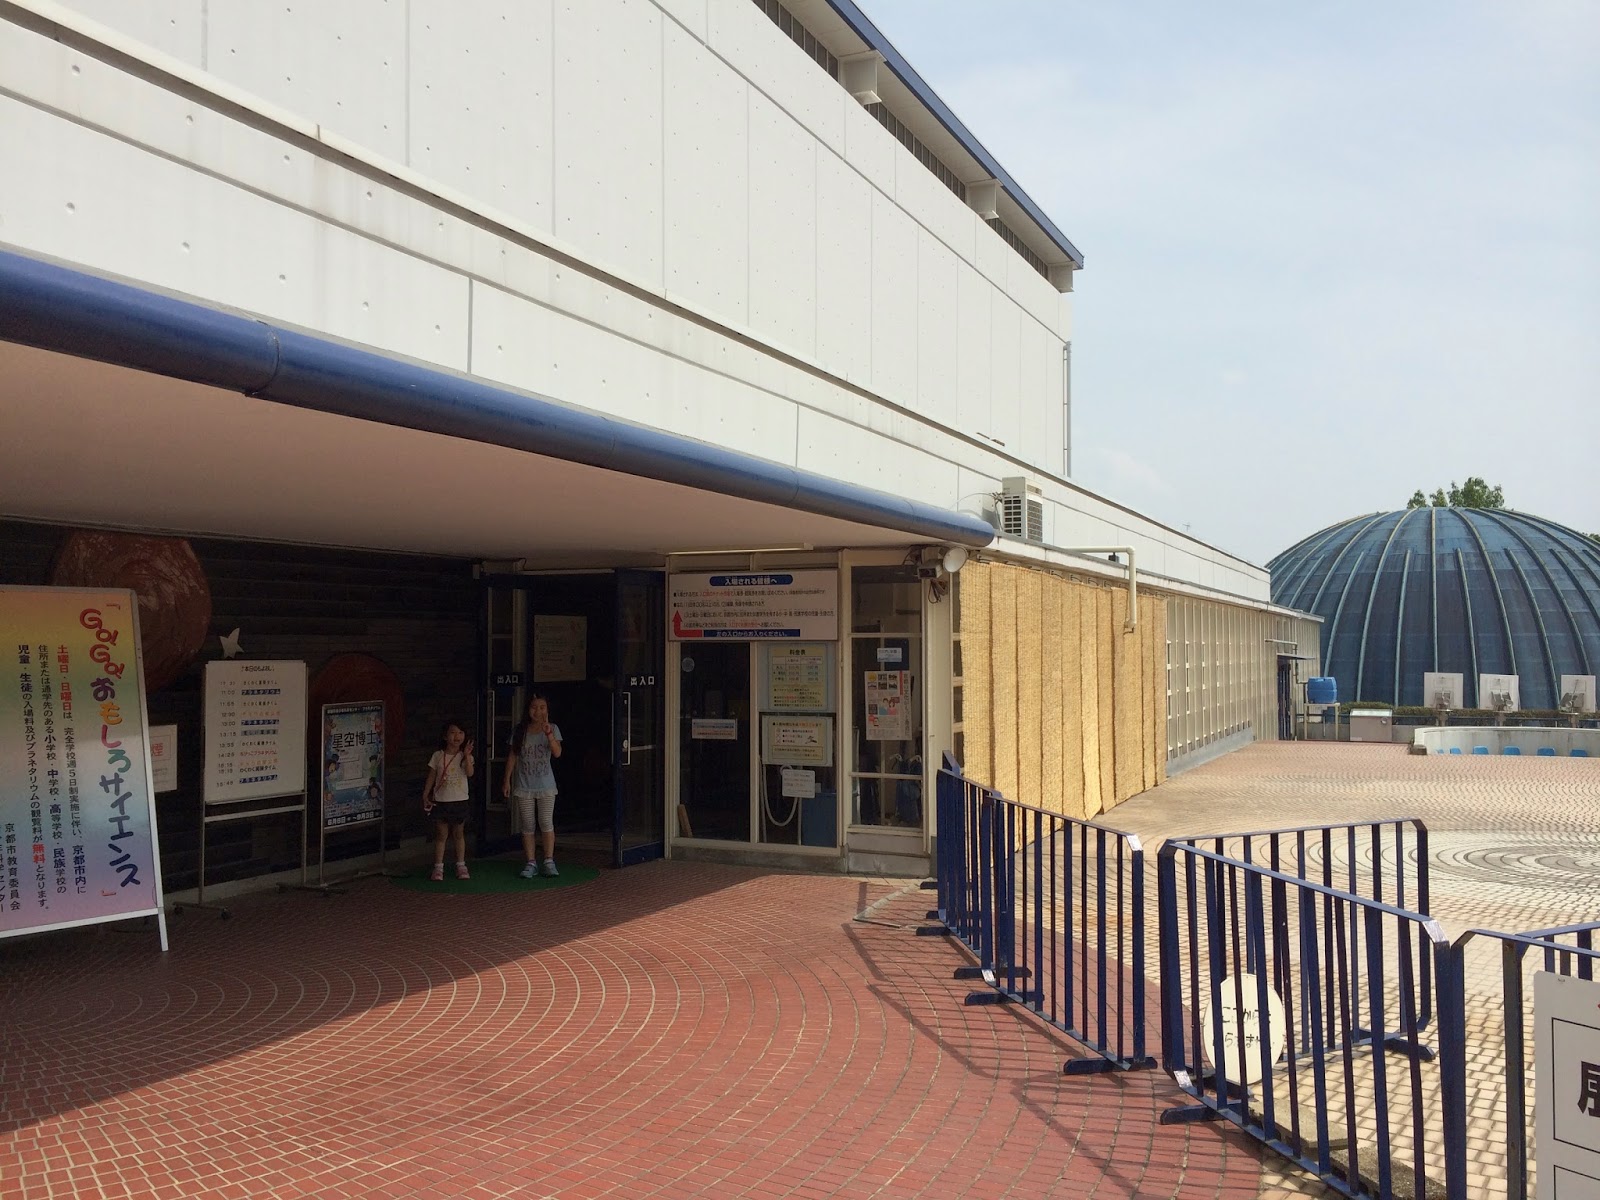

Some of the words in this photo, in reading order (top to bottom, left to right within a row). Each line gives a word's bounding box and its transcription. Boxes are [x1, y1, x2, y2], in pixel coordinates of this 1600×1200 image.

[497, 675, 519, 684] 出入口
[630, 676, 655, 686] 出入口
[332, 730, 377, 748] 星空博士
[5, 823, 21, 911] 京都市教育委員会
